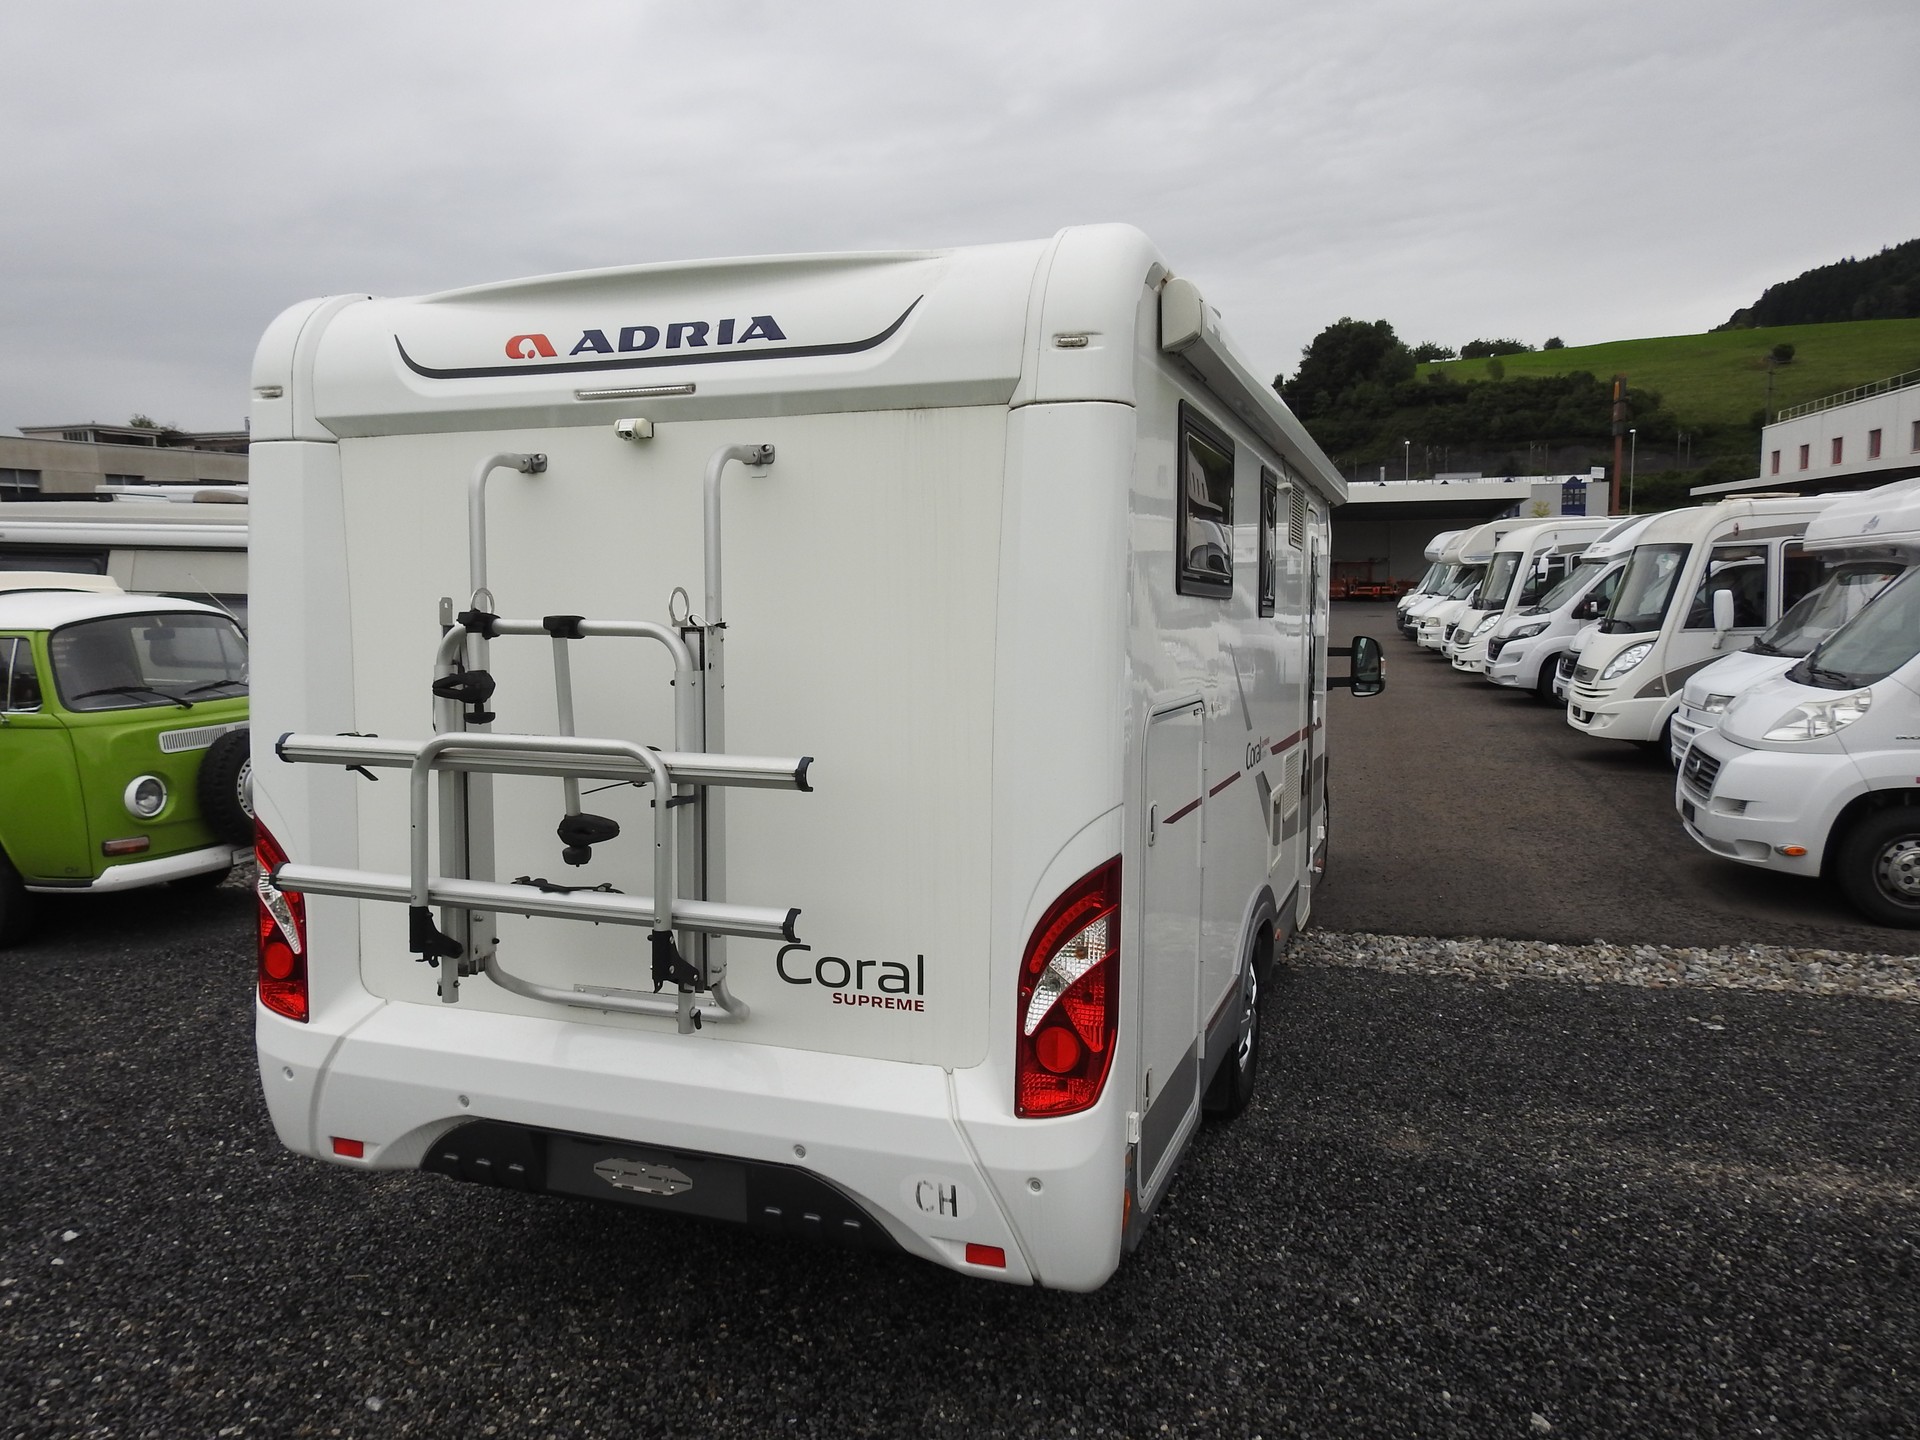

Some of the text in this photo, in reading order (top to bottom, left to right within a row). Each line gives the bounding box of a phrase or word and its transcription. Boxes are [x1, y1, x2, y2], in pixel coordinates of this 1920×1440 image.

[569, 315, 787, 356] ADRIA
[1245, 735, 1262, 770] Coral
[776, 943, 924, 996] Coral
[832, 992, 925, 1012] SUPREME
[915, 1180, 958, 1218] CH
